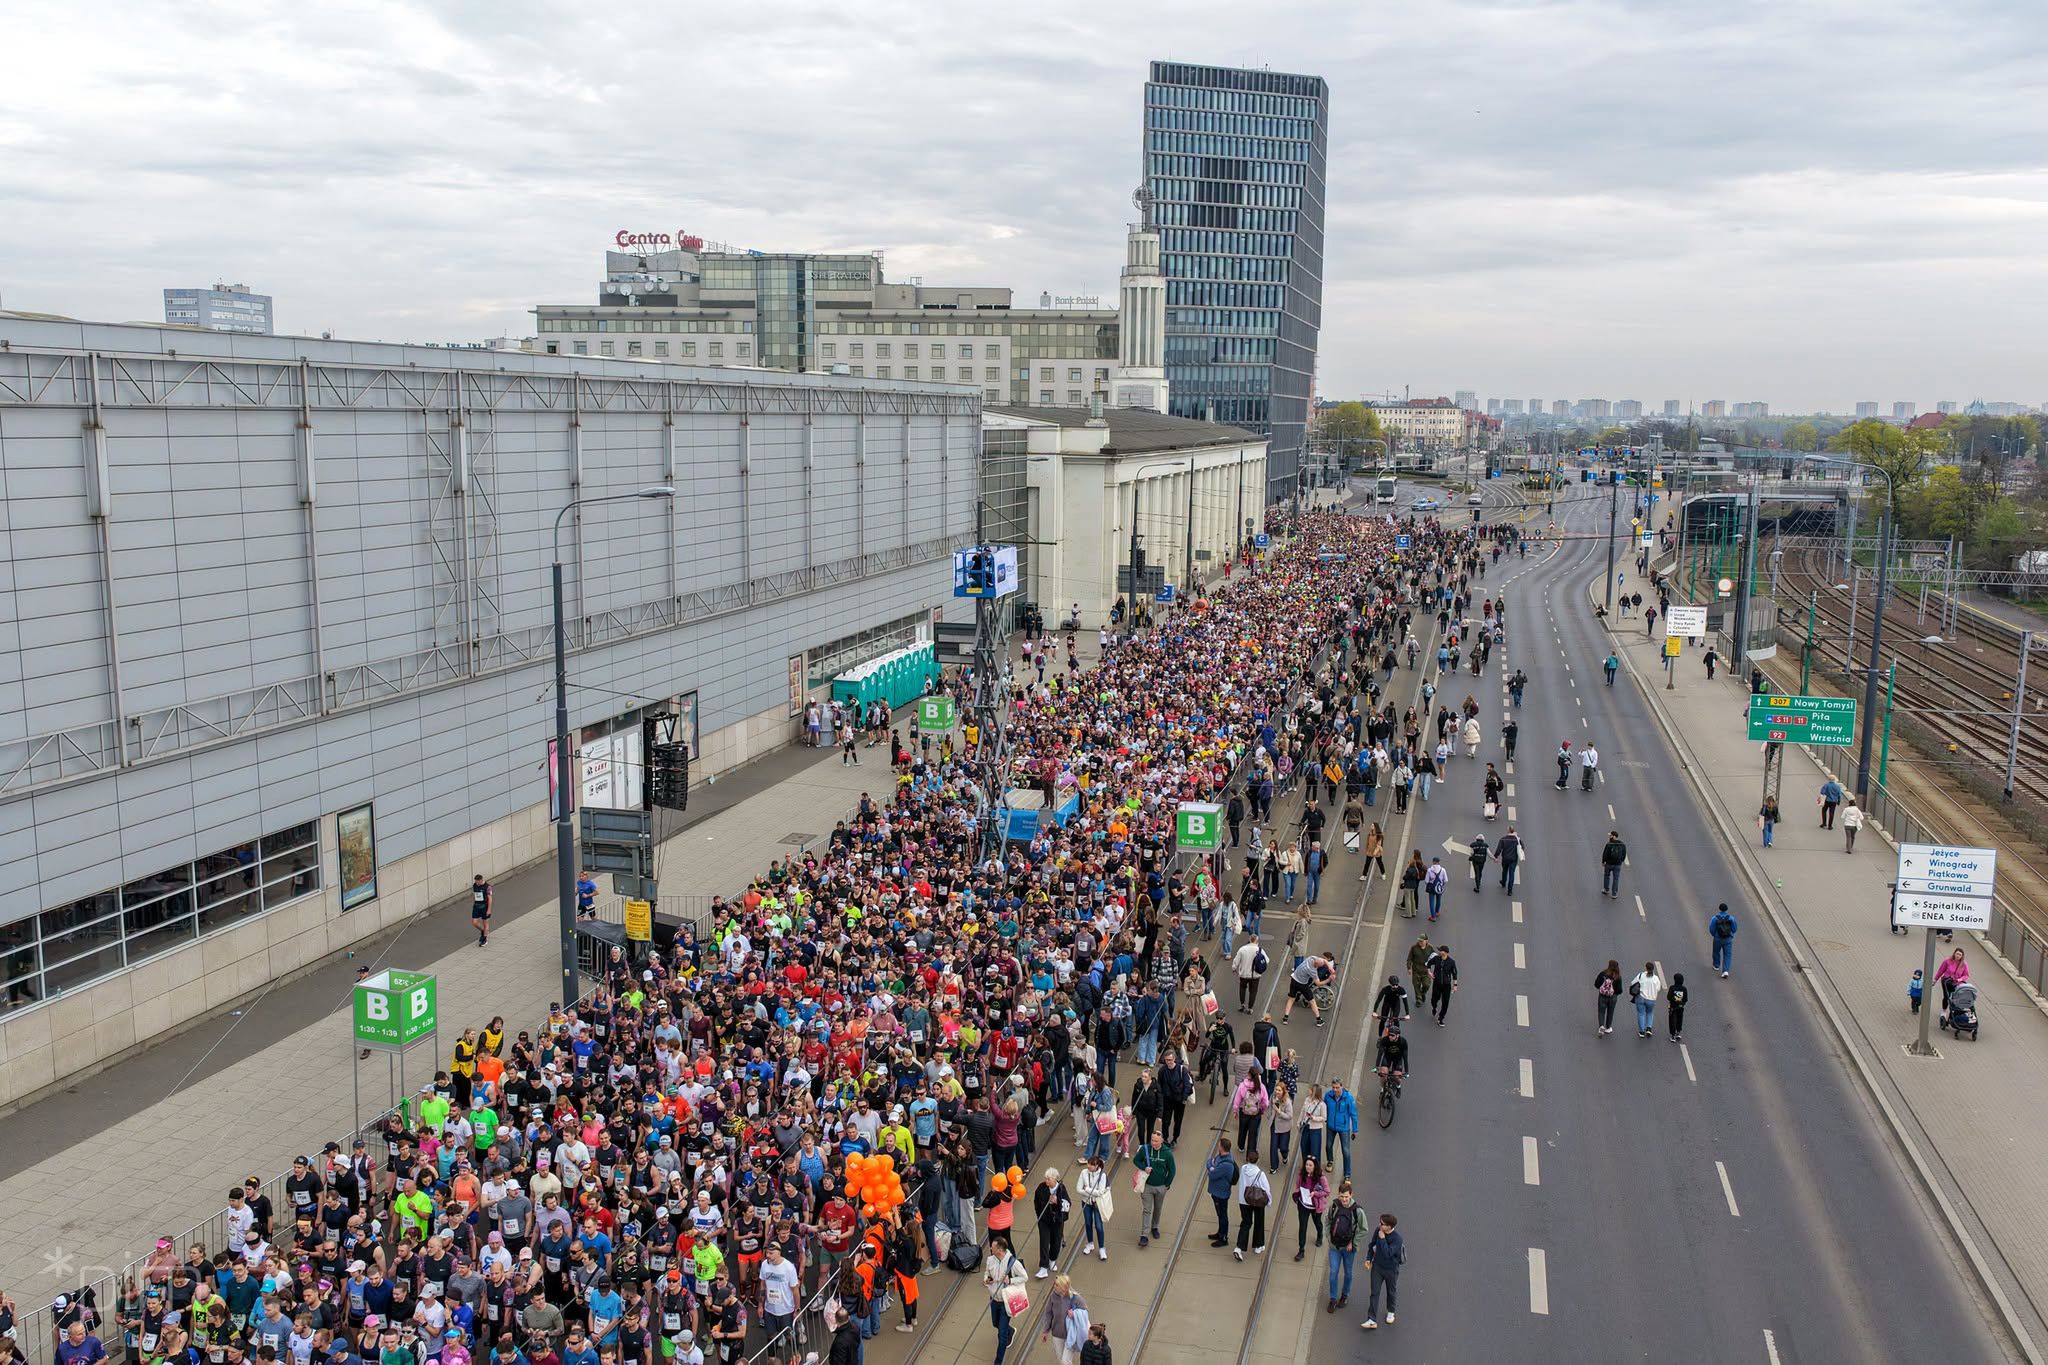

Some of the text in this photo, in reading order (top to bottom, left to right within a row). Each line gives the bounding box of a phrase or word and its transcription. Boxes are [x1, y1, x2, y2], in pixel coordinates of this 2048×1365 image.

[616, 230, 670, 248] Centra
[678, 229, 703, 249] Centra
[812, 271, 870, 280] SHERATON
[1055, 296, 1098, 304] Bank Polski
[1794, 699, 1819, 709] Nowy
[1822, 700, 1854, 710] Tomyśl
[926, 704, 938, 718] B
[1812, 712, 1830, 721] Piła
[1811, 723, 1842, 733] Pniewy
[1810, 733, 1851, 743] Września
[1188, 815, 1206, 834] B
[1930, 849, 1960, 858] Jeżyce
[1929, 859, 1978, 871] Winogrady
[1928, 869, 1968, 880] Piątkowo
[1928, 882, 1972, 892] Grunwald
[1923, 901, 1975, 911] Szpital Klin.
[1922, 912, 1983, 923] ENEA Stadion
[366, 992, 390, 1021] B
[411, 988, 428, 1020] B
[360, 1024, 375, 1033] 1:30
[382, 1028, 398, 1037] 1:39
[406, 1026, 417, 1036] 1:30
